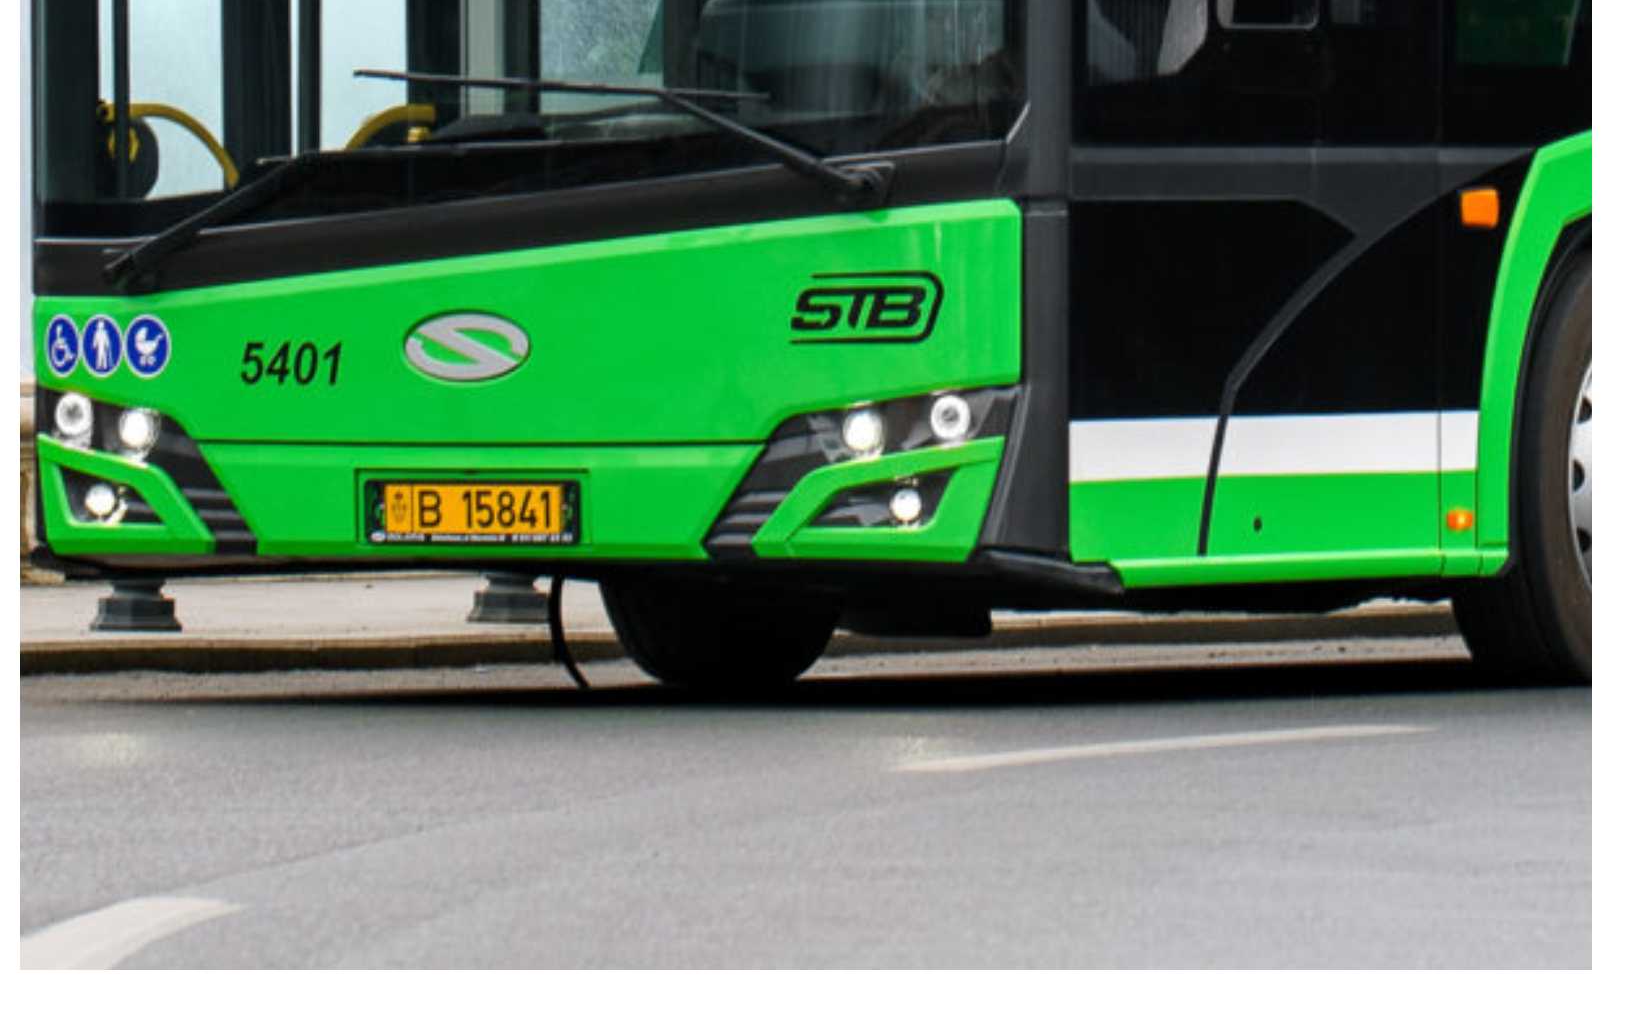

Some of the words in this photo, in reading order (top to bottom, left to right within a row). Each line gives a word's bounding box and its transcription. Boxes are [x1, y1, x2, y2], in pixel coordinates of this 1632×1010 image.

[790, 285, 927, 331] STB
[240, 341, 343, 386] 5401
[418, 490, 442, 529] B
[462, 490, 551, 529] 15841
